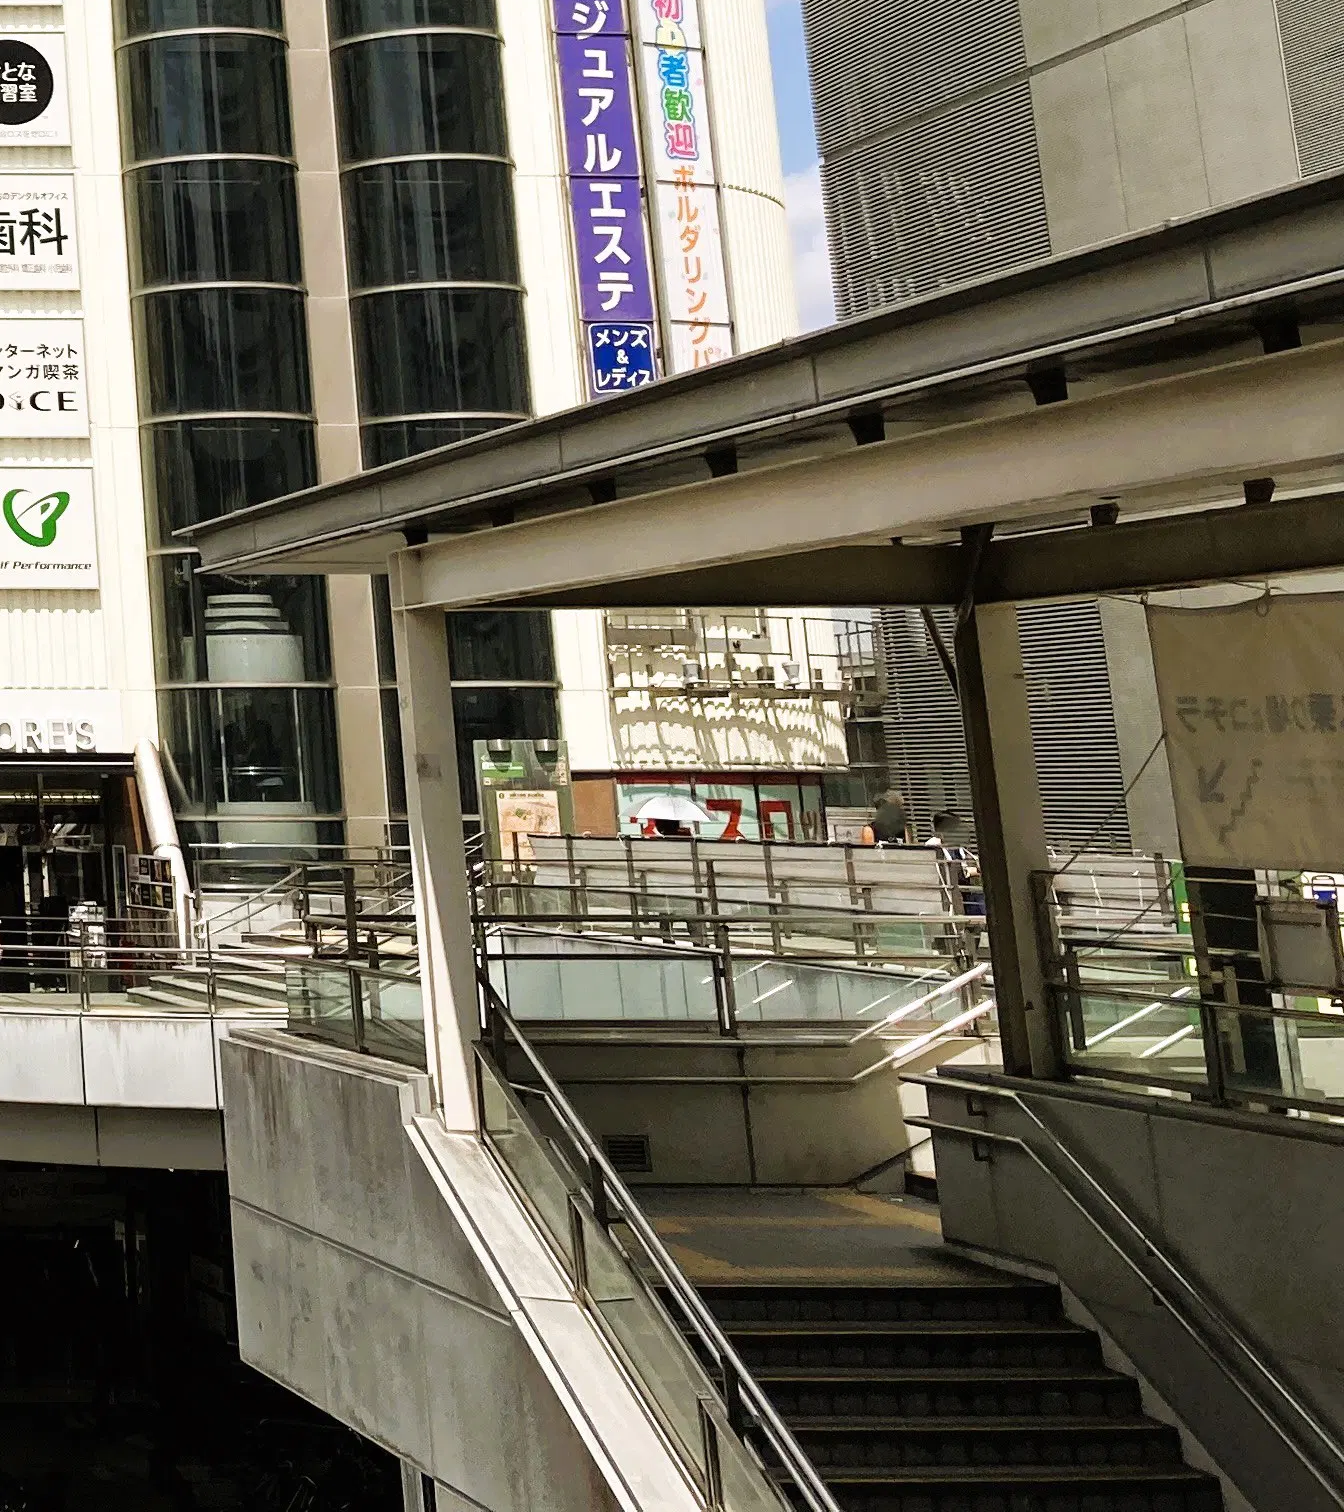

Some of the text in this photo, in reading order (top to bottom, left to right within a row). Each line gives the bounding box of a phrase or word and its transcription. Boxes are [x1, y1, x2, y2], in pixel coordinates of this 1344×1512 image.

[594, 328, 649, 349] メンズ
[596, 366, 652, 388] レディス
[12, 559, 92, 571] Performance
